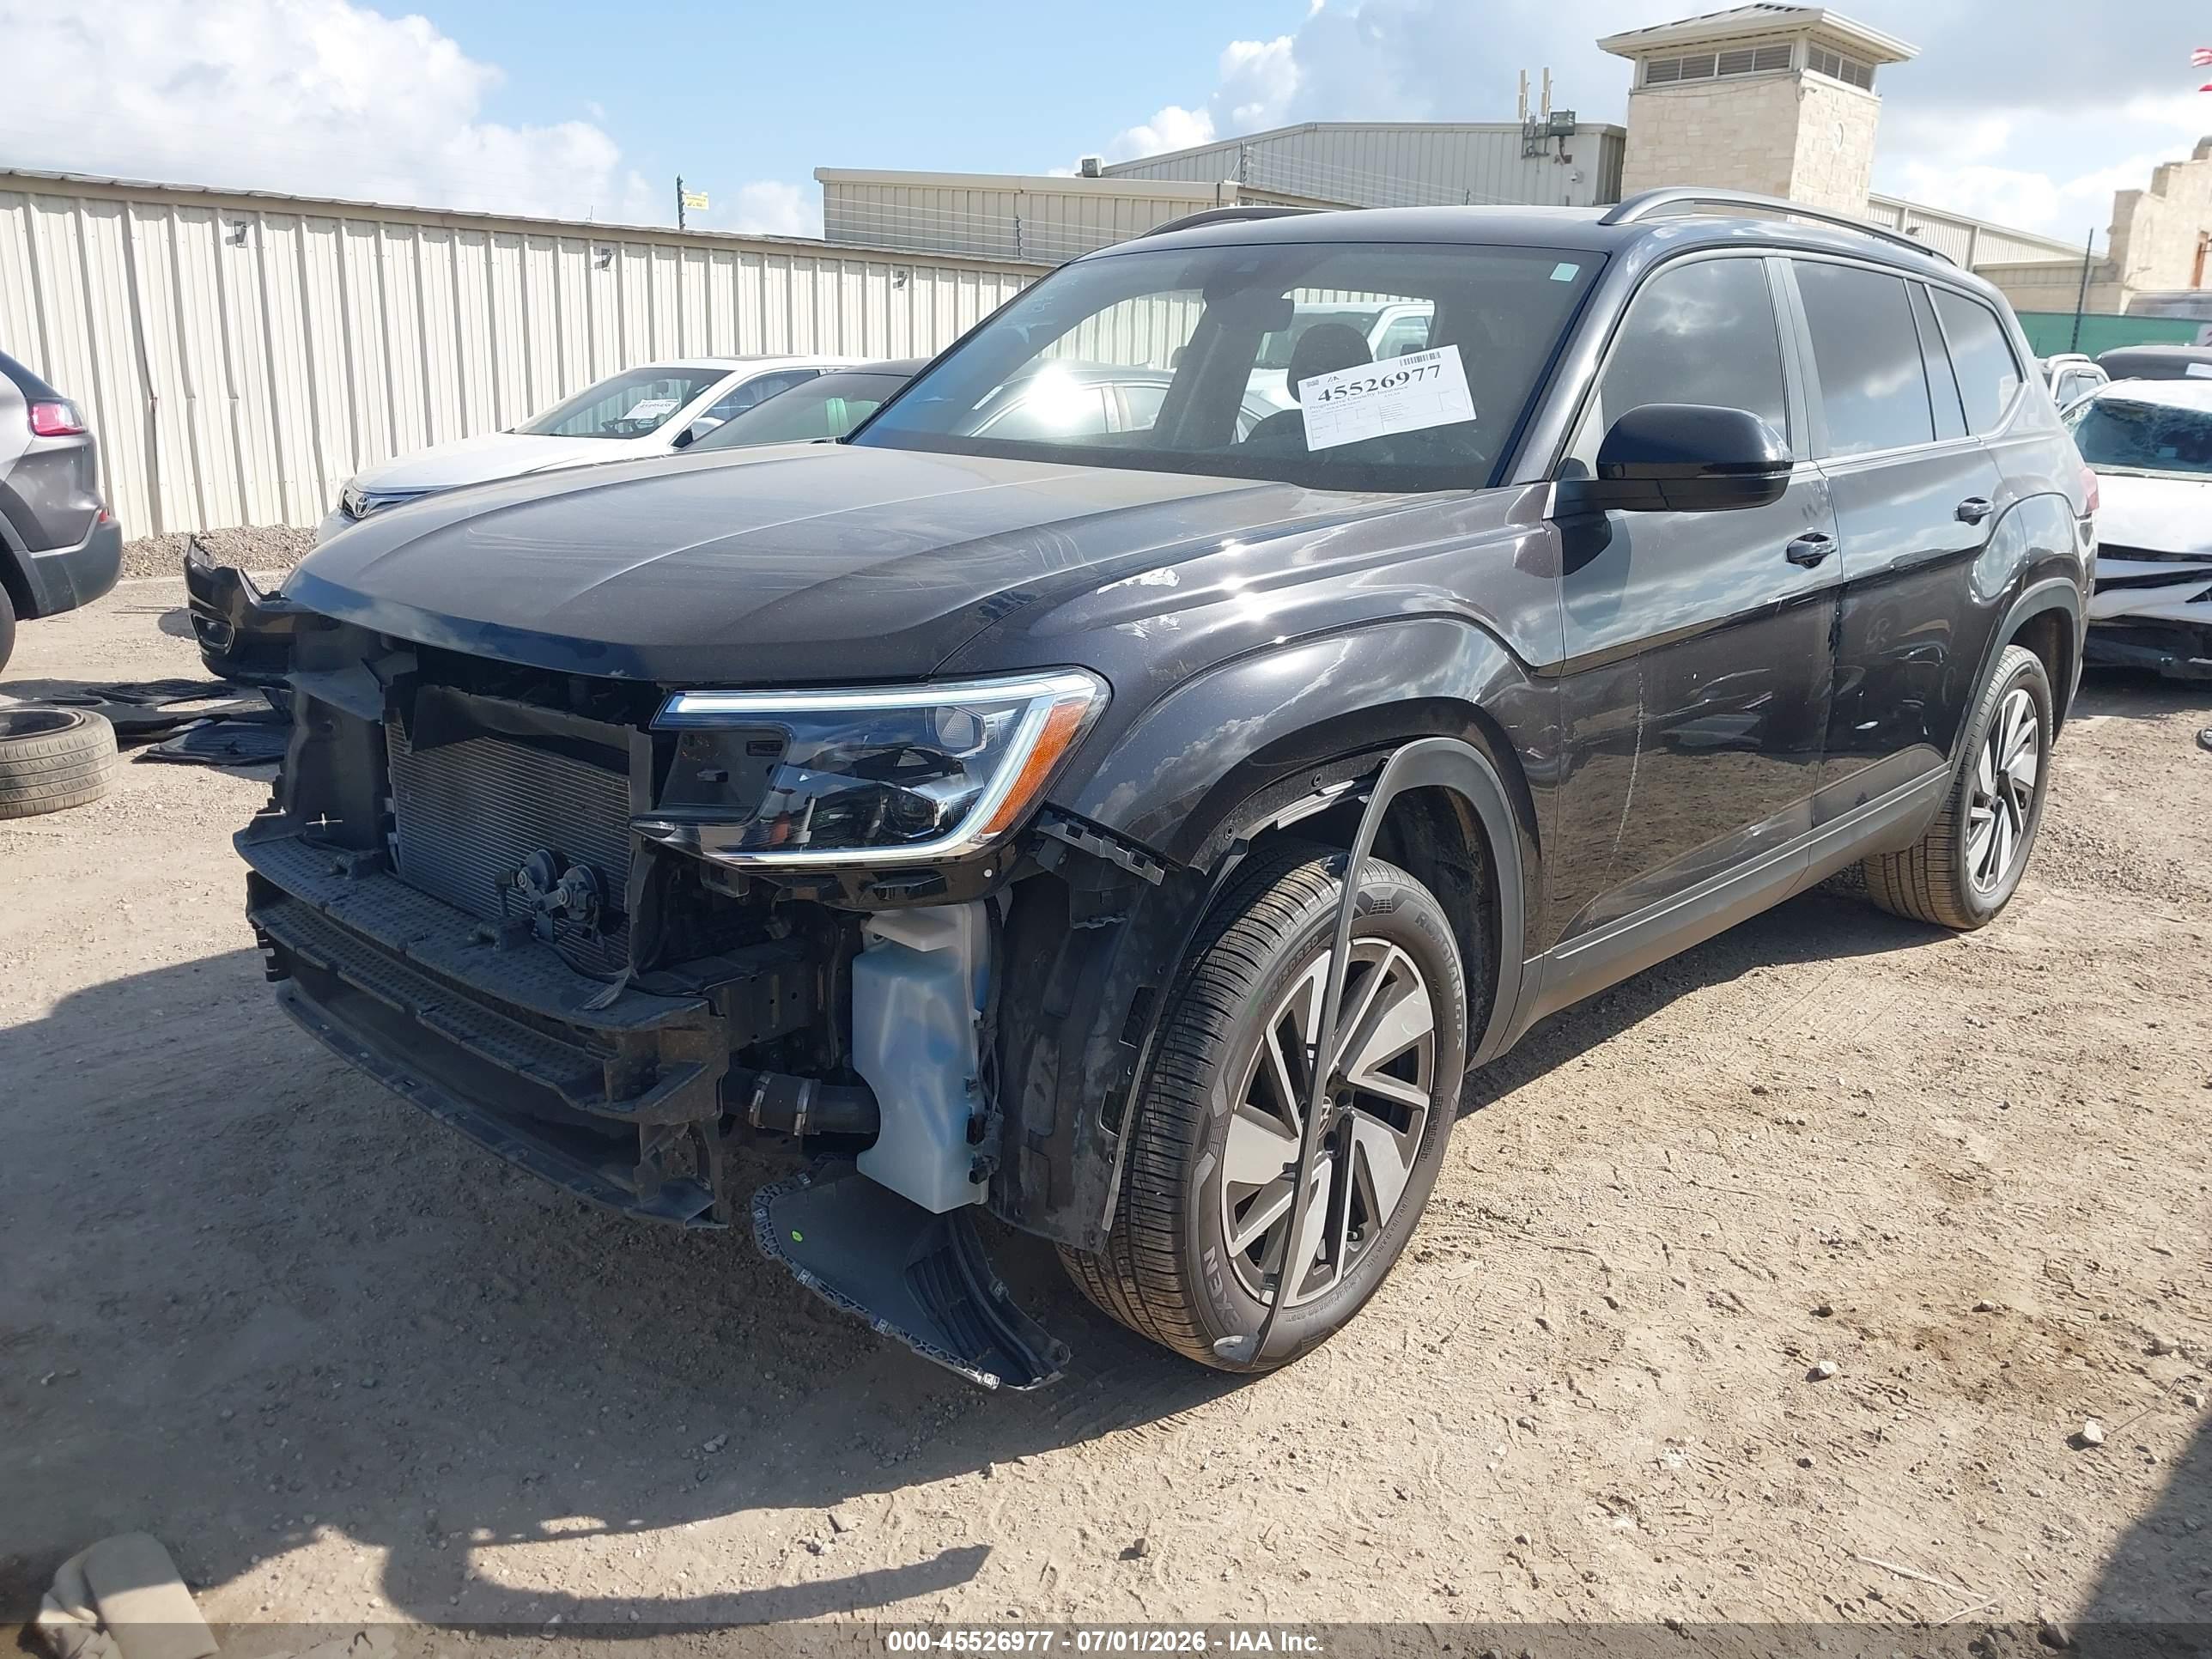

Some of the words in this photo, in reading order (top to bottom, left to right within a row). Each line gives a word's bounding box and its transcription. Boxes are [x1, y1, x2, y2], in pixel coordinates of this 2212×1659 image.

[1310, 398, 1346, 411] Progressive
[1377, 386, 1409, 396] Insurance
[1318, 364, 1441, 402] 45526977
